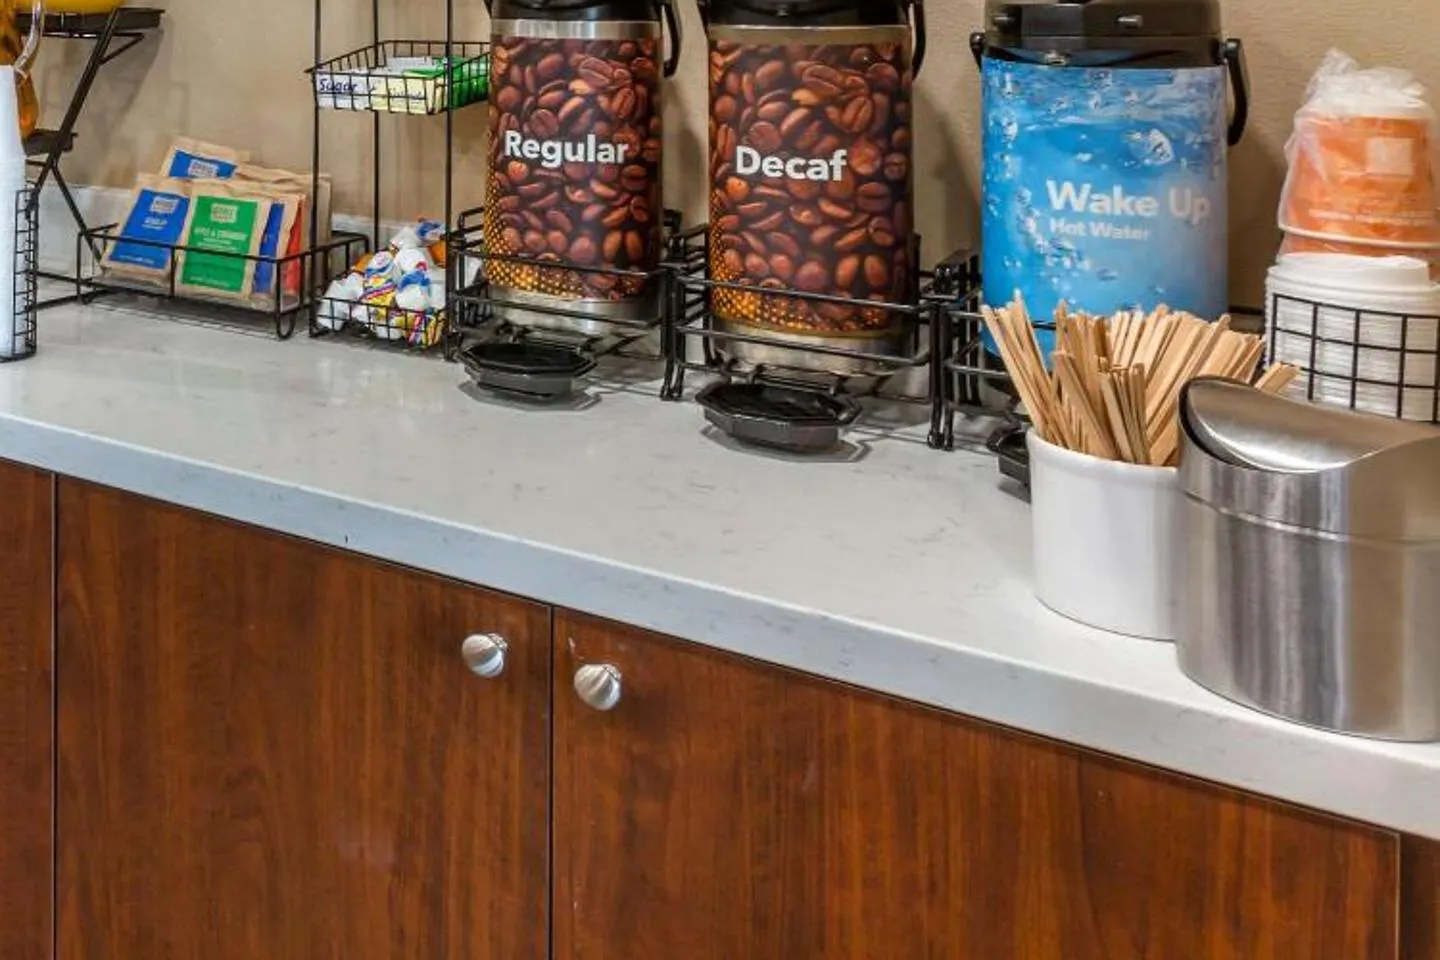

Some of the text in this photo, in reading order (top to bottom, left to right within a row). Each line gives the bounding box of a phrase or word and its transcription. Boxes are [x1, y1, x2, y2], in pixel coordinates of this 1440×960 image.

[504, 129, 630, 169] Regular
[735, 145, 848, 182] Decaf
[1046, 178, 1210, 226] Wake Up
[1049, 217, 1152, 240] Hot Water
